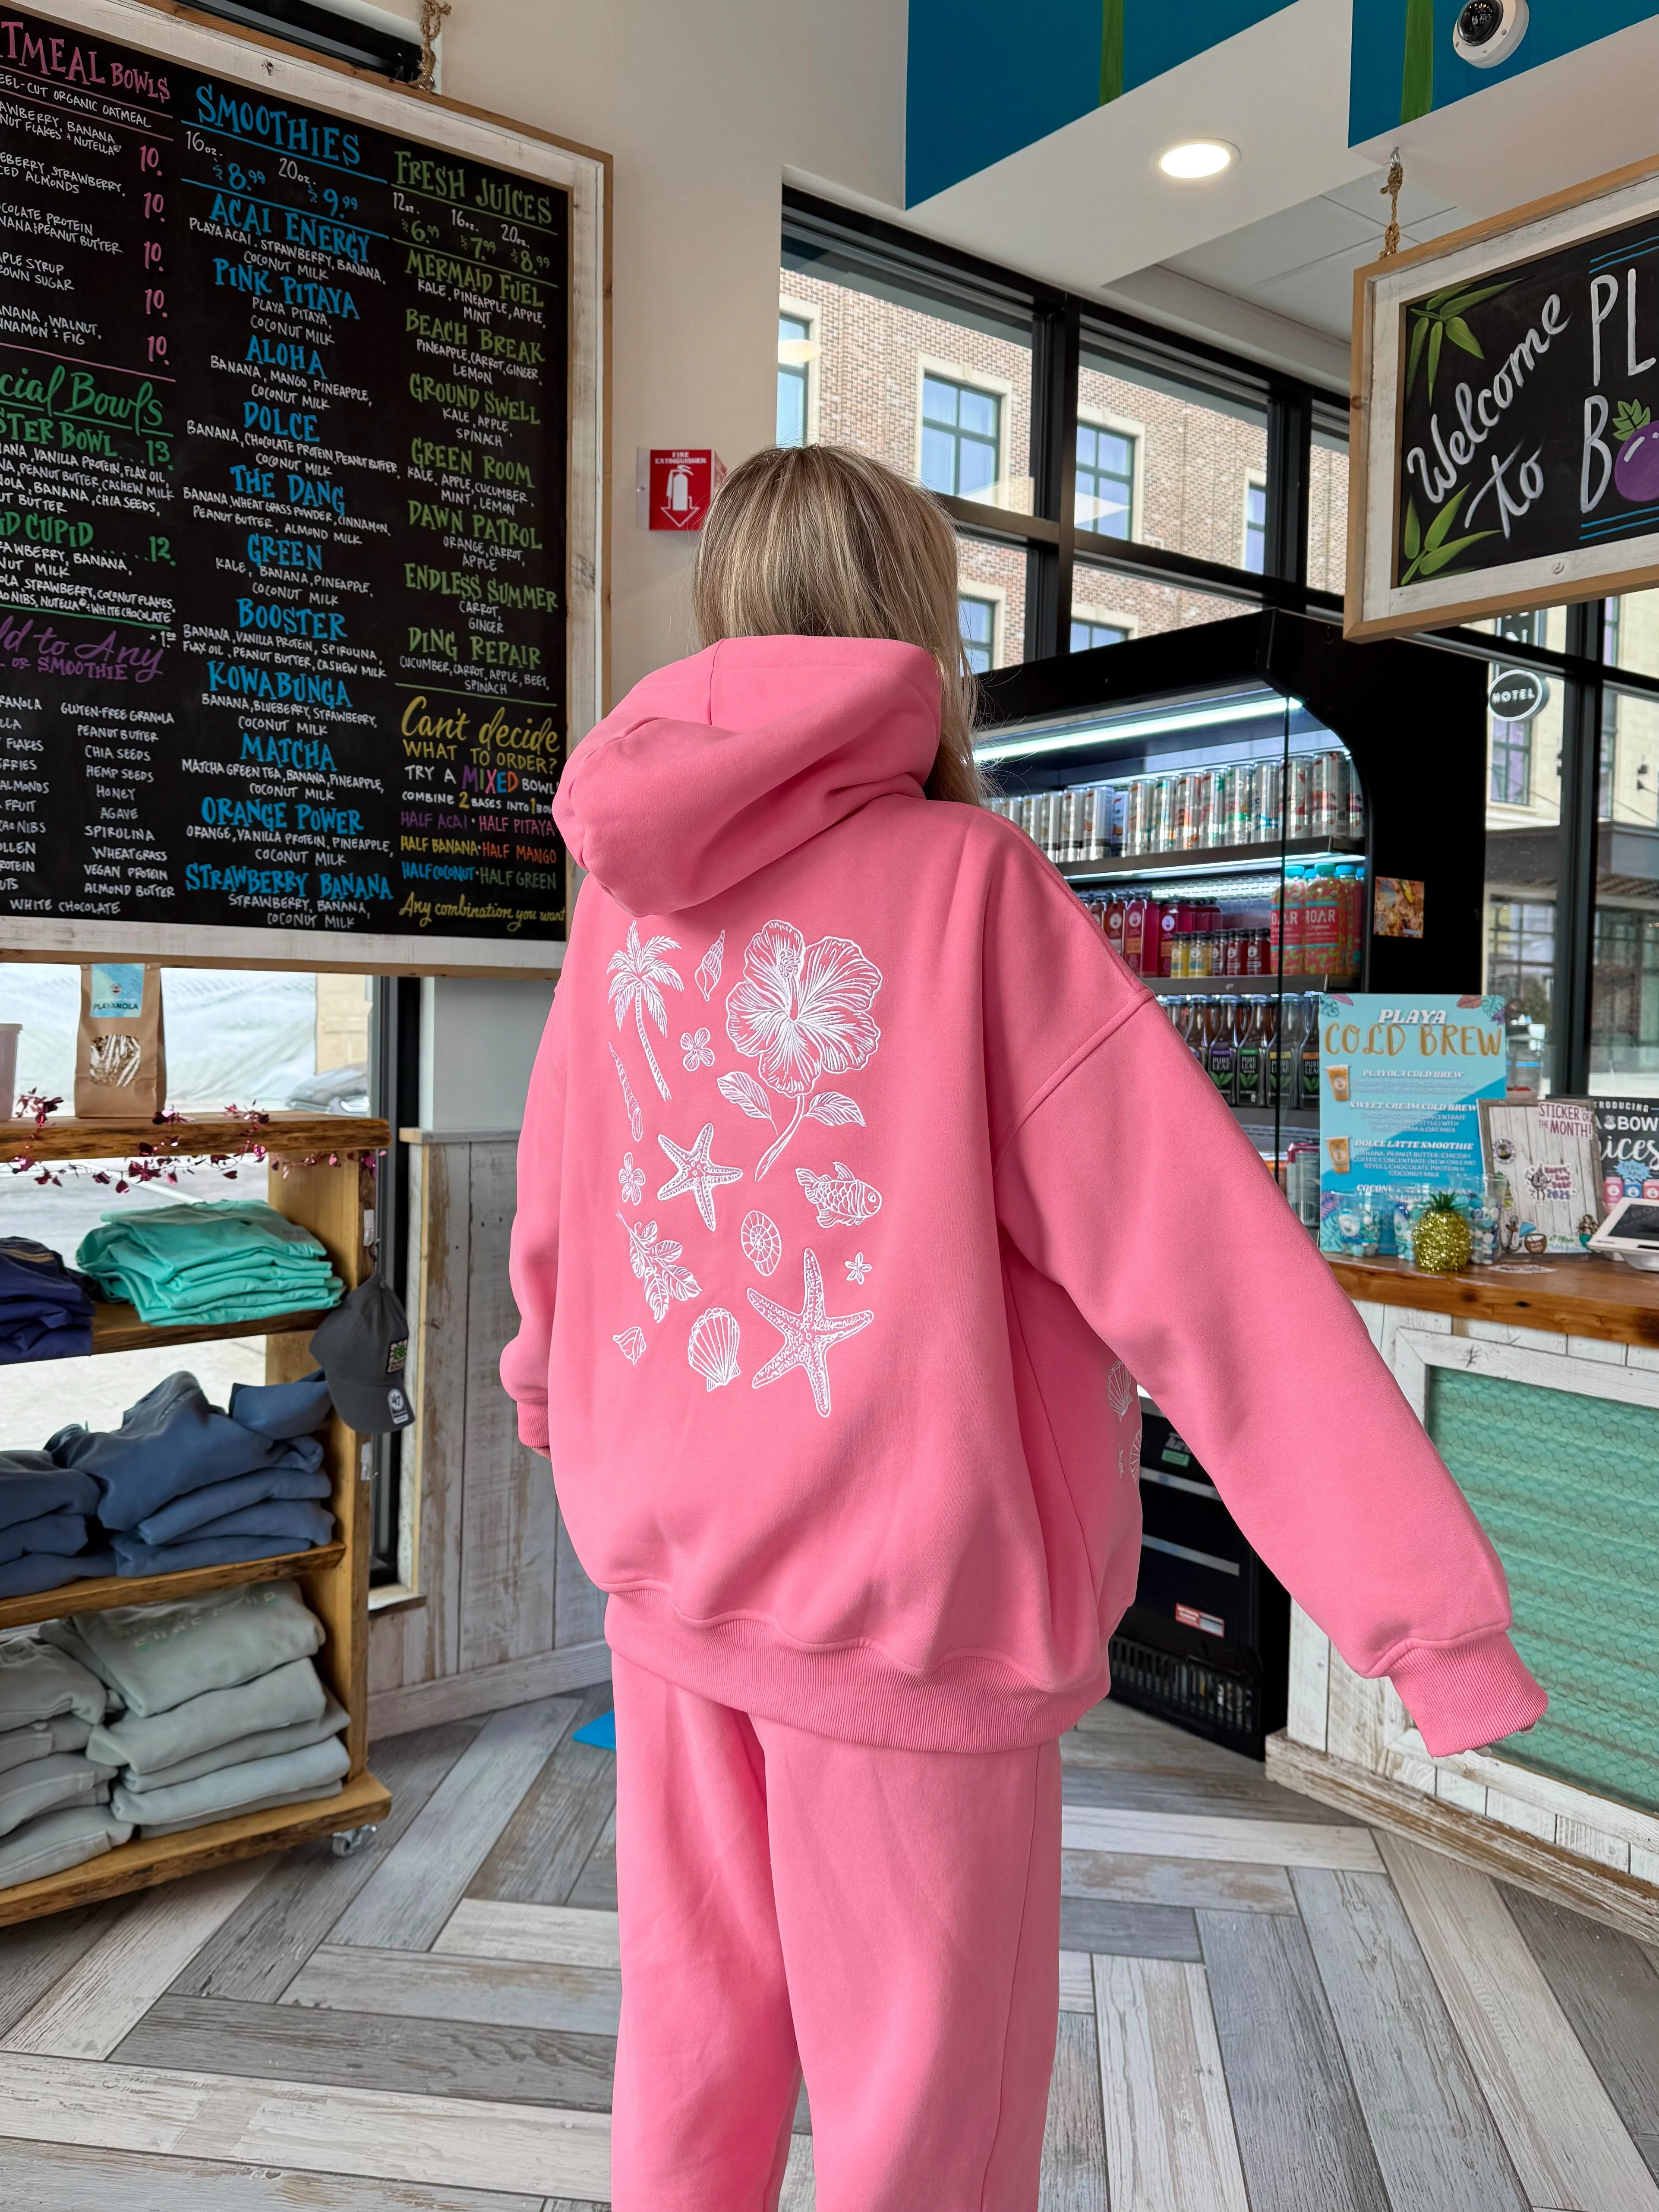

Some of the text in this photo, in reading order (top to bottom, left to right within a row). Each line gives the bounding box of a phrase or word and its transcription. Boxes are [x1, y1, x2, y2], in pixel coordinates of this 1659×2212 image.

[110, 63, 170, 101] BOWLS
[54, 91, 151, 127] ORGANIC OATMEAL
[196, 84, 359, 164] SMOOTHIES
[67, 121, 115, 143] BANANA
[26, 171, 79, 193] ALMONDS
[392, 152, 551, 224] FRESH JUICES
[47, 213, 92, 236] PROTEIN
[210, 193, 369, 265] ACAI ENERGY
[26, 259, 64, 275] SYRUP
[35, 275, 74, 290] SUGAR
[244, 251, 328, 280] COCONUT MILK
[405, 250, 543, 306] MERMAID FUEL
[213, 258, 359, 319] PINK PITAYA
[464, 306, 491, 325] MINT
[406, 309, 543, 364] BEACH BREAK
[246, 335, 326, 379] ALOHA
[454, 363, 492, 385] LEMON
[64, 372, 162, 435] Bowls
[252, 384, 330, 410] COCONUT MILK
[410, 374, 540, 424] GROUND SWELL
[1407, 293, 1572, 504] Welcome
[60, 422, 117, 456] BOWL
[243, 402, 320, 442] DOLCE
[456, 429, 502, 449] SPINACH
[412, 438, 533, 488] GREEN ROOM
[230, 465, 344, 517] THE DANG
[1465, 434, 1546, 540] to
[480, 497, 514, 515] LEMON
[25, 513, 93, 547] CUPID
[409, 501, 542, 549] DAWN PATROL
[248, 533, 322, 570] GREEN
[463, 553, 496, 571] APPLE
[405, 563, 556, 612] ENDLESS SUMMER
[237, 598, 347, 641] BOOSTER
[469, 620, 504, 634] GINGER
[33, 628, 163, 682] to Any
[409, 628, 539, 669] DING REPAIR
[12, 657, 127, 680] OR SMOOTHIE
[207, 660, 352, 710] KOWABUNGA
[1492, 688, 1535, 704] HOTEL
[402, 696, 559, 754] Can't decide
[240, 733, 337, 771] MATCHA
[403, 739, 556, 773] WHAT TO ORDER?
[97, 785, 135, 800] HONEY
[405, 765, 434, 780] TRY
[444, 769, 456, 784] A
[463, 766, 518, 794] MIXED
[101, 807, 138, 819] AGAVE
[202, 797, 363, 835] ORANGE POWER
[402, 791, 535, 814] COMBINE 2 BASES INTO 1
[85, 826, 155, 841] SPIRULINA
[402, 810, 555, 836] HALF ACAI HALF PITAYA
[255, 849, 346, 866] COCONUT MILK
[401, 836, 556, 863] HALF BANANA HALF MANGO
[186, 863, 393, 900] STRAWBERRY BANANA
[402, 861, 556, 889] HALF COCONUT HALF GREEN
[9, 899, 120, 914] WHITE CHOCOLATE
[268, 912, 353, 928] COCONUT MILK
[399, 892, 565, 932] Any combination you want
[1305, 909, 1336, 923] ROAR
[1379, 1009, 1448, 1025] PLAYA
[1324, 1022, 1502, 1057] COLD BREW
[1539, 1104, 1579, 1120] STICKER
[1539, 1120, 1592, 1138] THE MONTH!
[1355, 1139, 1473, 1151] DOLCE LATTE SMOOTHIE
